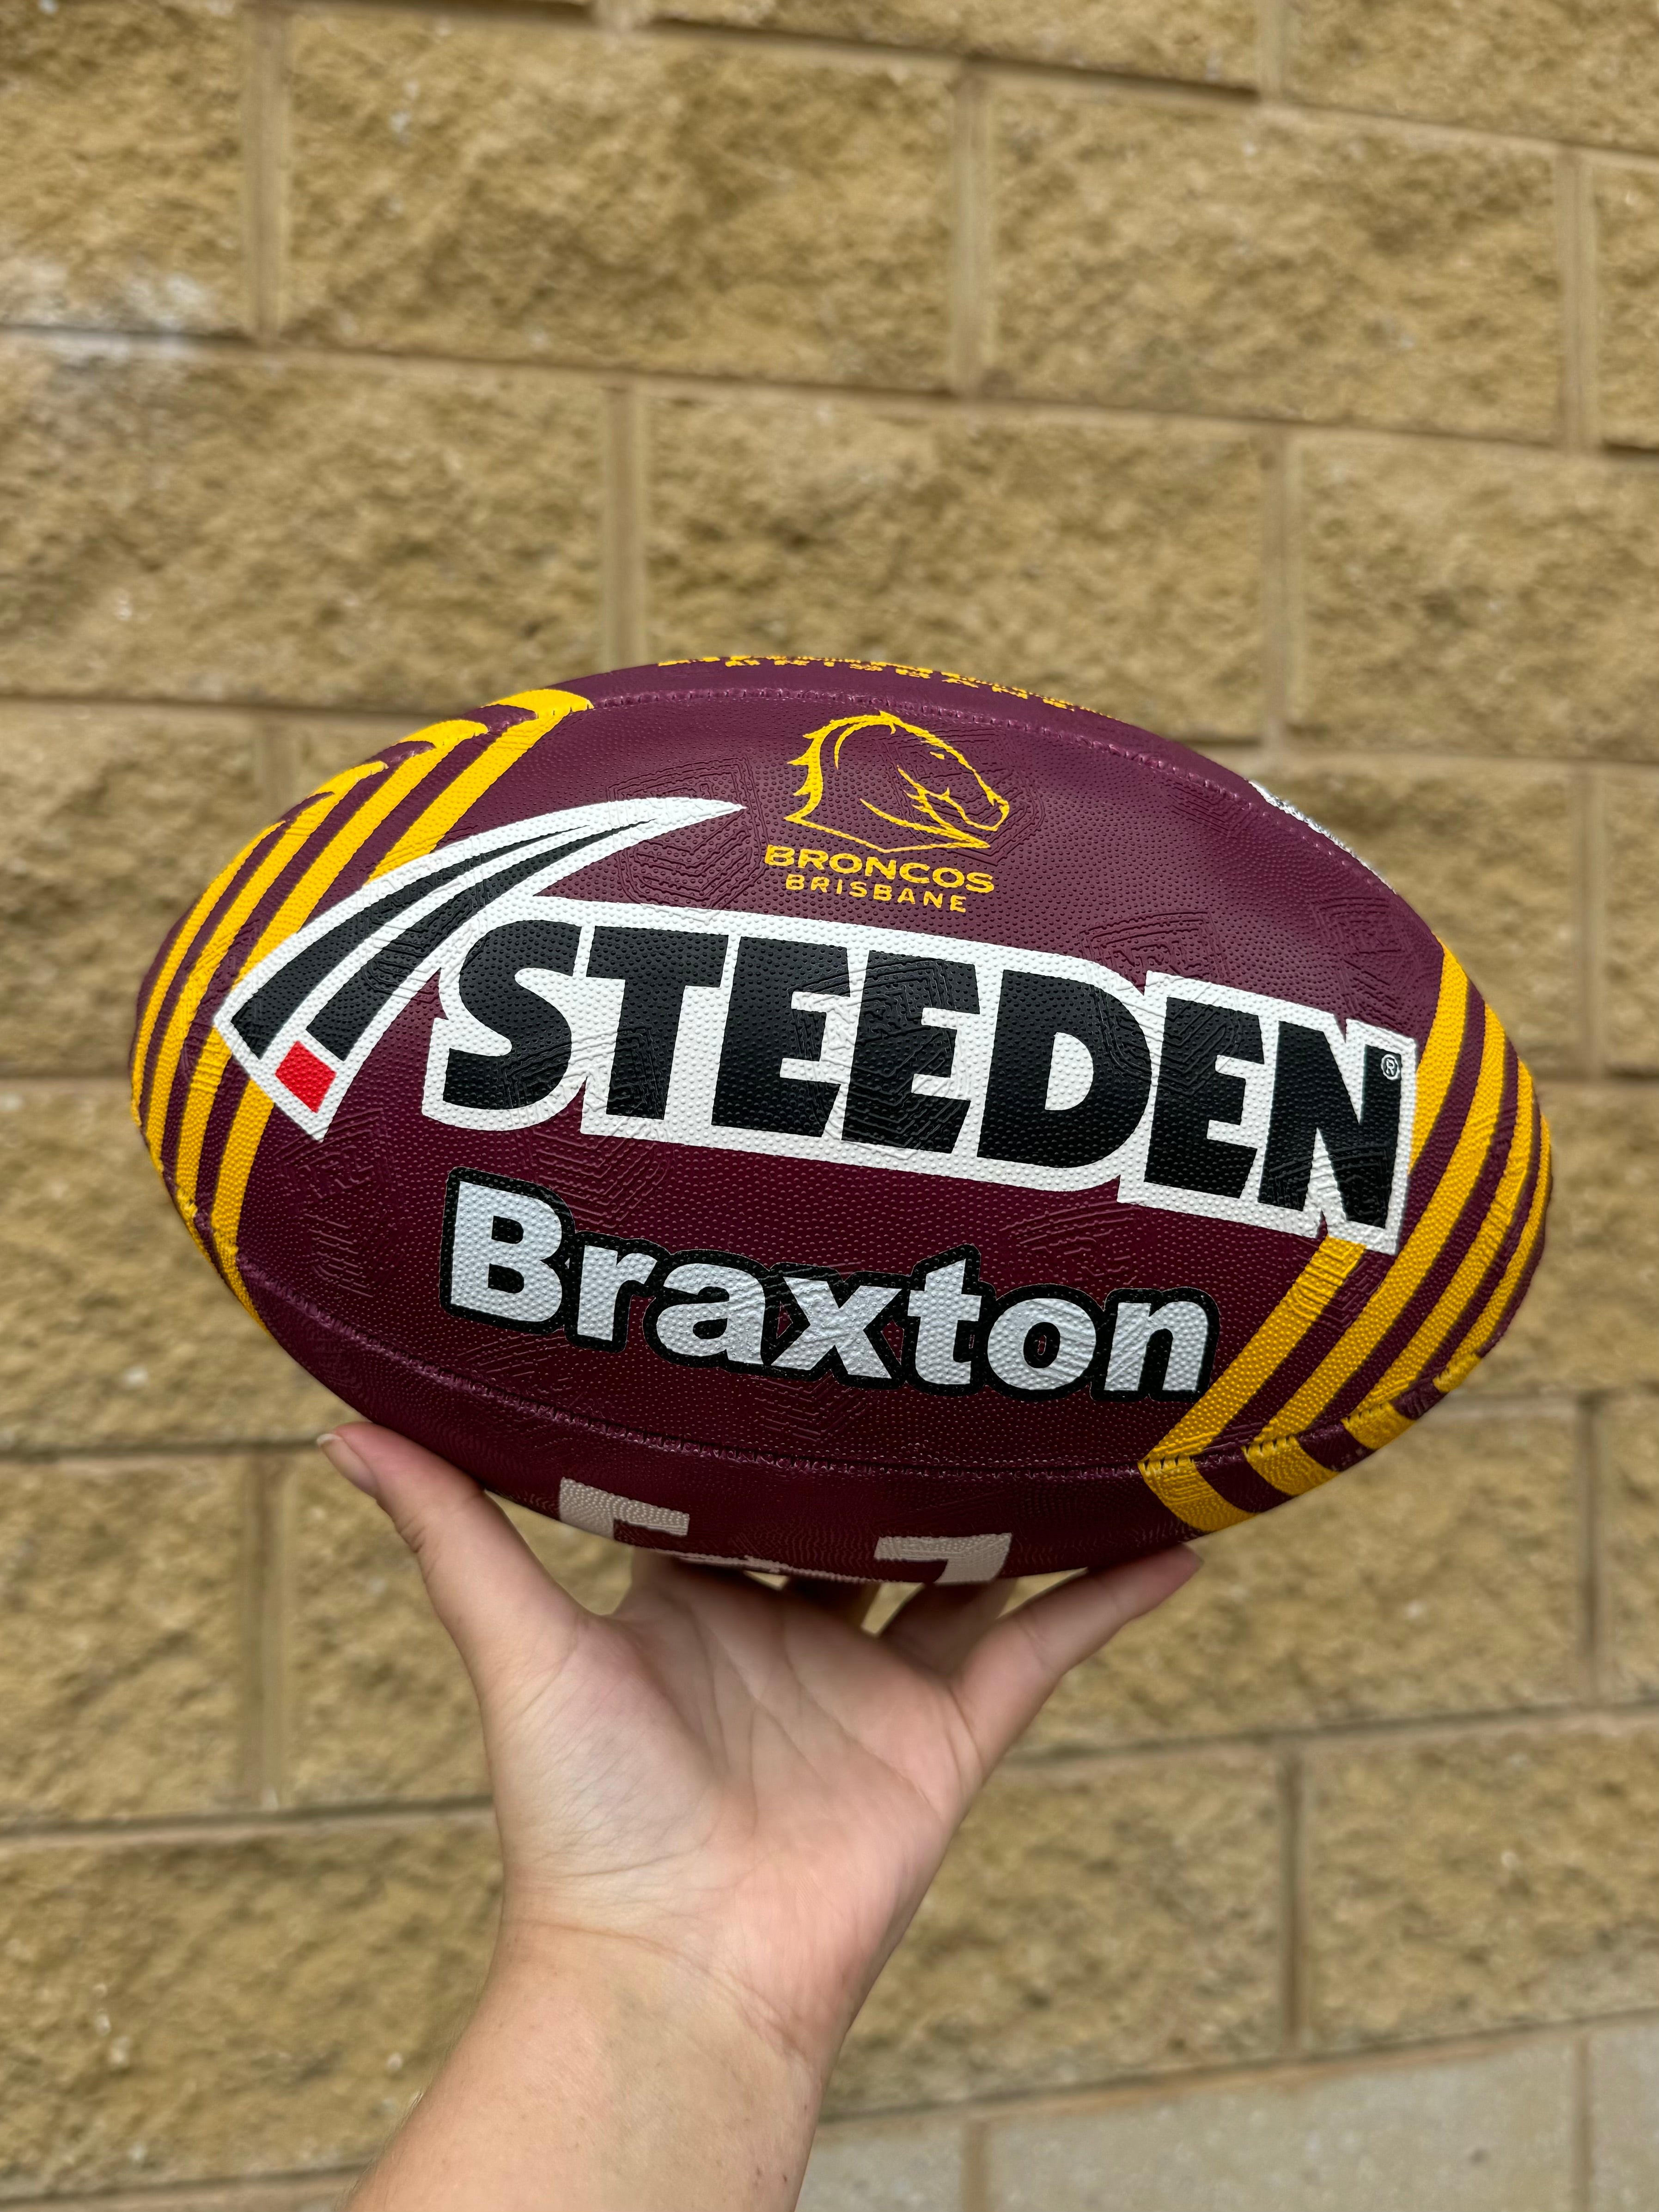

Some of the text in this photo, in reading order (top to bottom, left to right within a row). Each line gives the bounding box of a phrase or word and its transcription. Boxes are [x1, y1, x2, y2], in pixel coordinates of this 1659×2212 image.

[765, 845, 994, 893] BRONCOS
[786, 874, 966, 912] BRISBANE
[442, 920, 1402, 1228] STEEDEN
[449, 1181, 1210, 1393] Braxton
